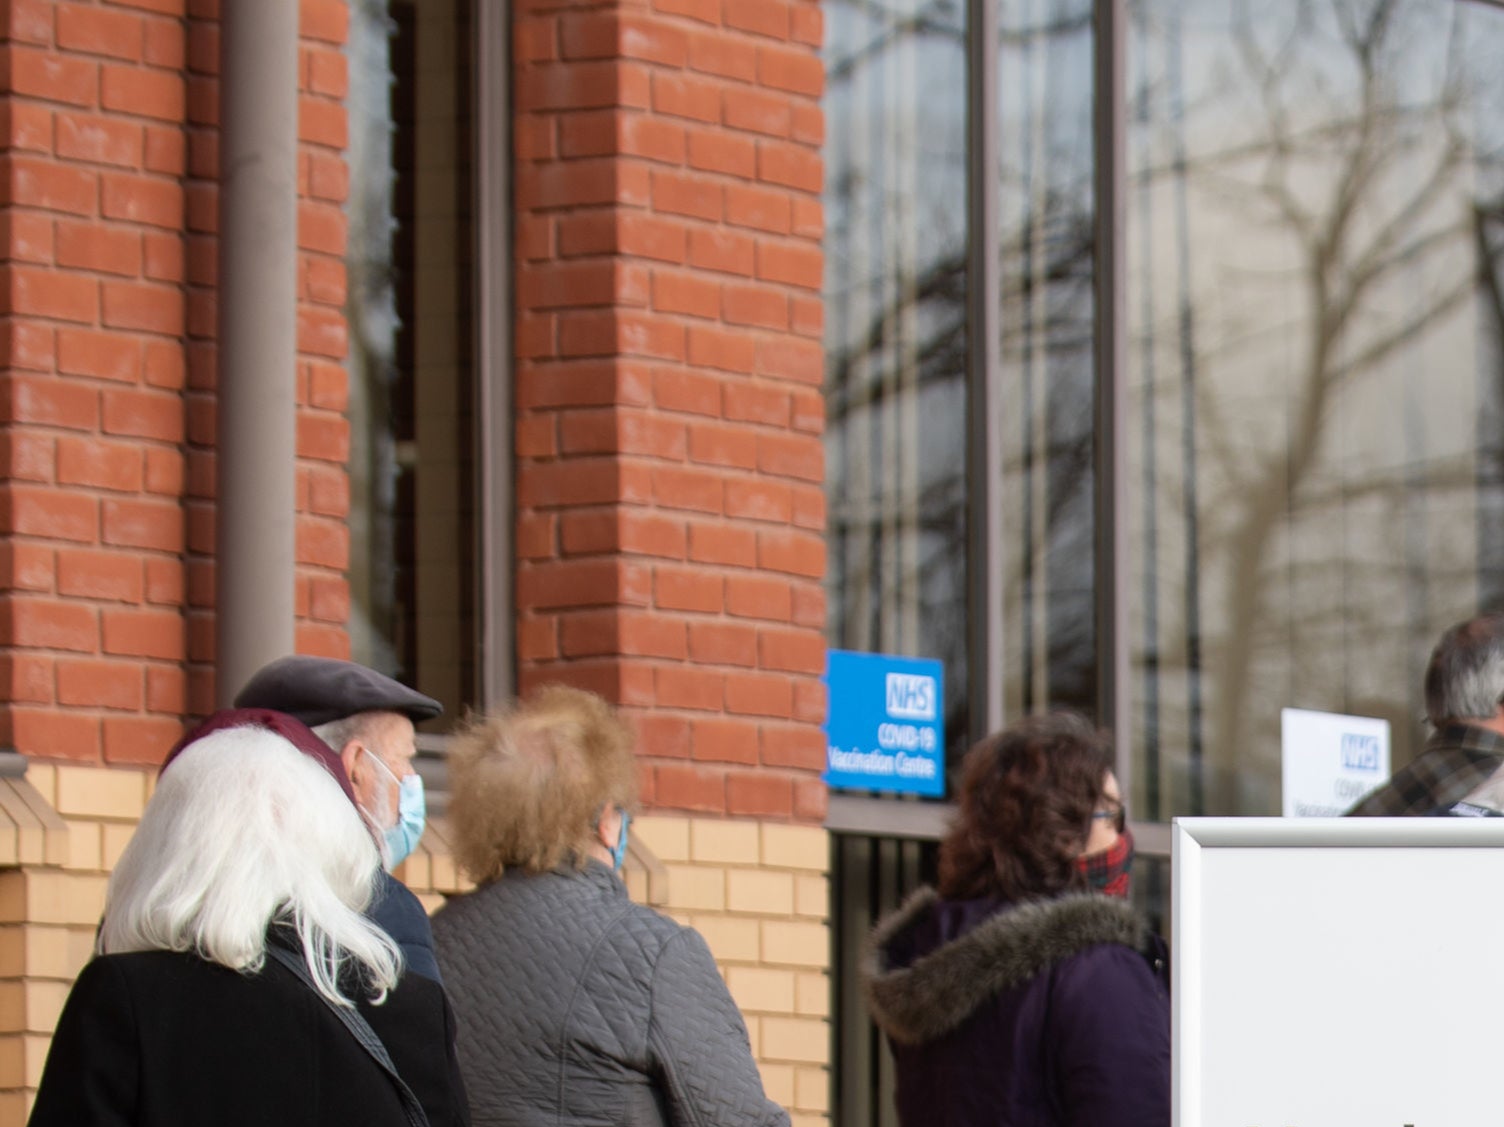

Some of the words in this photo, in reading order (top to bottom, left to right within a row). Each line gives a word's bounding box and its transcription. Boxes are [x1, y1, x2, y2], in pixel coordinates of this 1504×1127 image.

[887, 675, 932, 713] NHS
[878, 722, 935, 753] COVID-19
[829, 746, 894, 776] Vaccination
[895, 751, 935, 780] Centre
